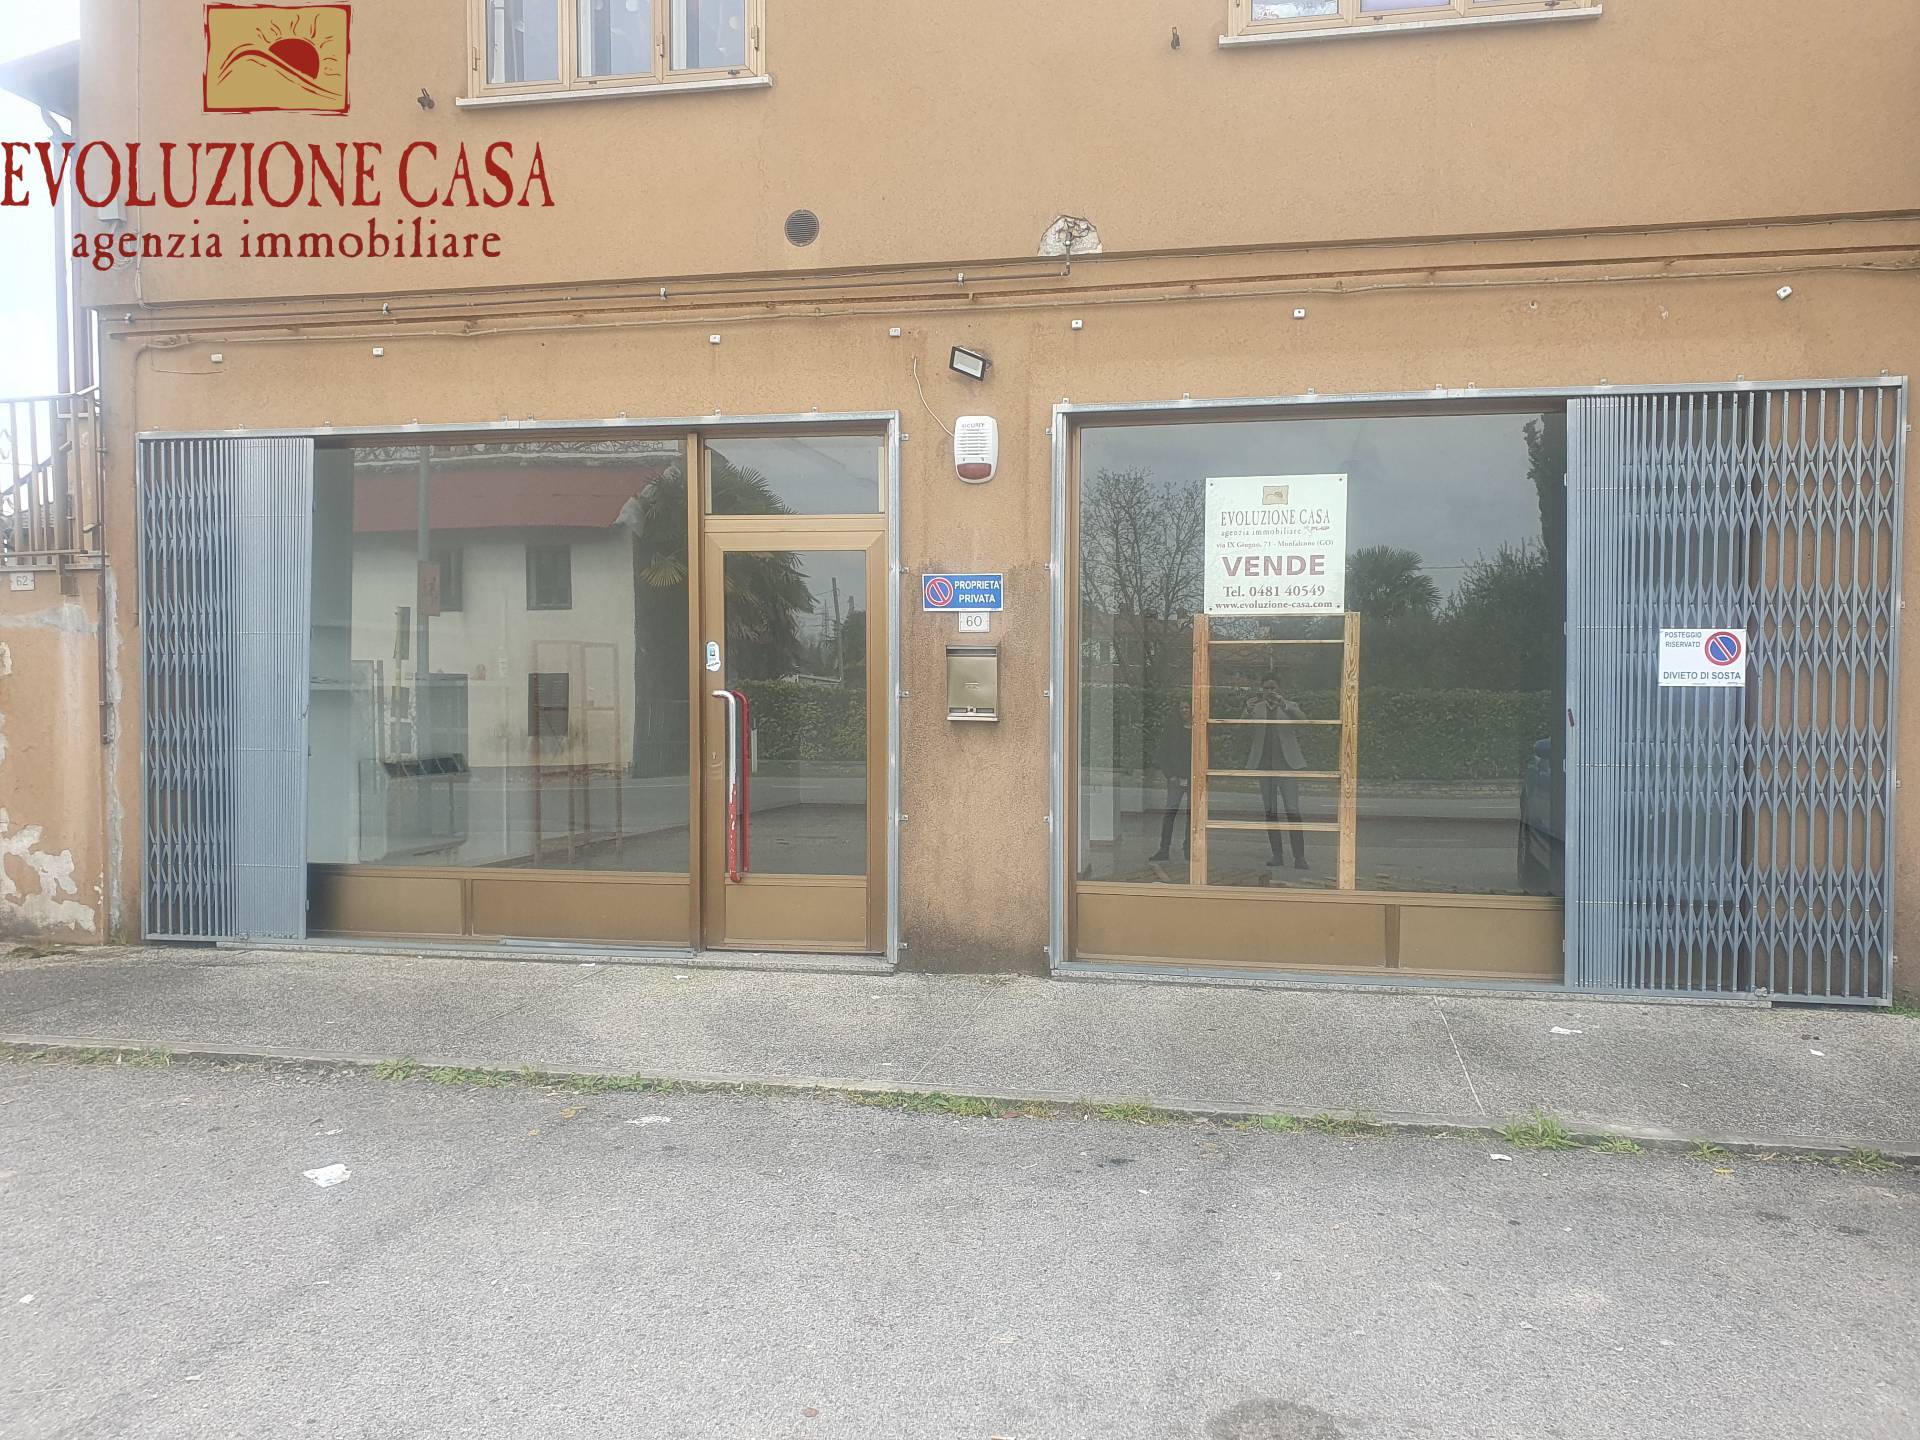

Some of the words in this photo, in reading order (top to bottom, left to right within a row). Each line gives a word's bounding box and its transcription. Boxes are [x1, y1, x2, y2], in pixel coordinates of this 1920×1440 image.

[1221, 509, 1296, 526] EVOLUZIONE
[1299, 508, 1330, 525] CASA
[1221, 529, 1249, 538] agenzia
[1252, 527, 1302, 536] immobiliare
[1222, 555, 1325, 576] VENDE
[1222, 585, 1245, 597] Tel.
[1249, 584, 1279, 597] 0481
[1284, 584, 1325, 597] 40549
[958, 594, 996, 603] PRIVATA
[1215, 600, 1333, 609] www.evoluzione-casa.com
[966, 616, 982, 627] 60
[1663, 671, 1698, 680] DIVIETO
[1700, 671, 1709, 680] DI
[1711, 671, 1741, 680] SOSTA
